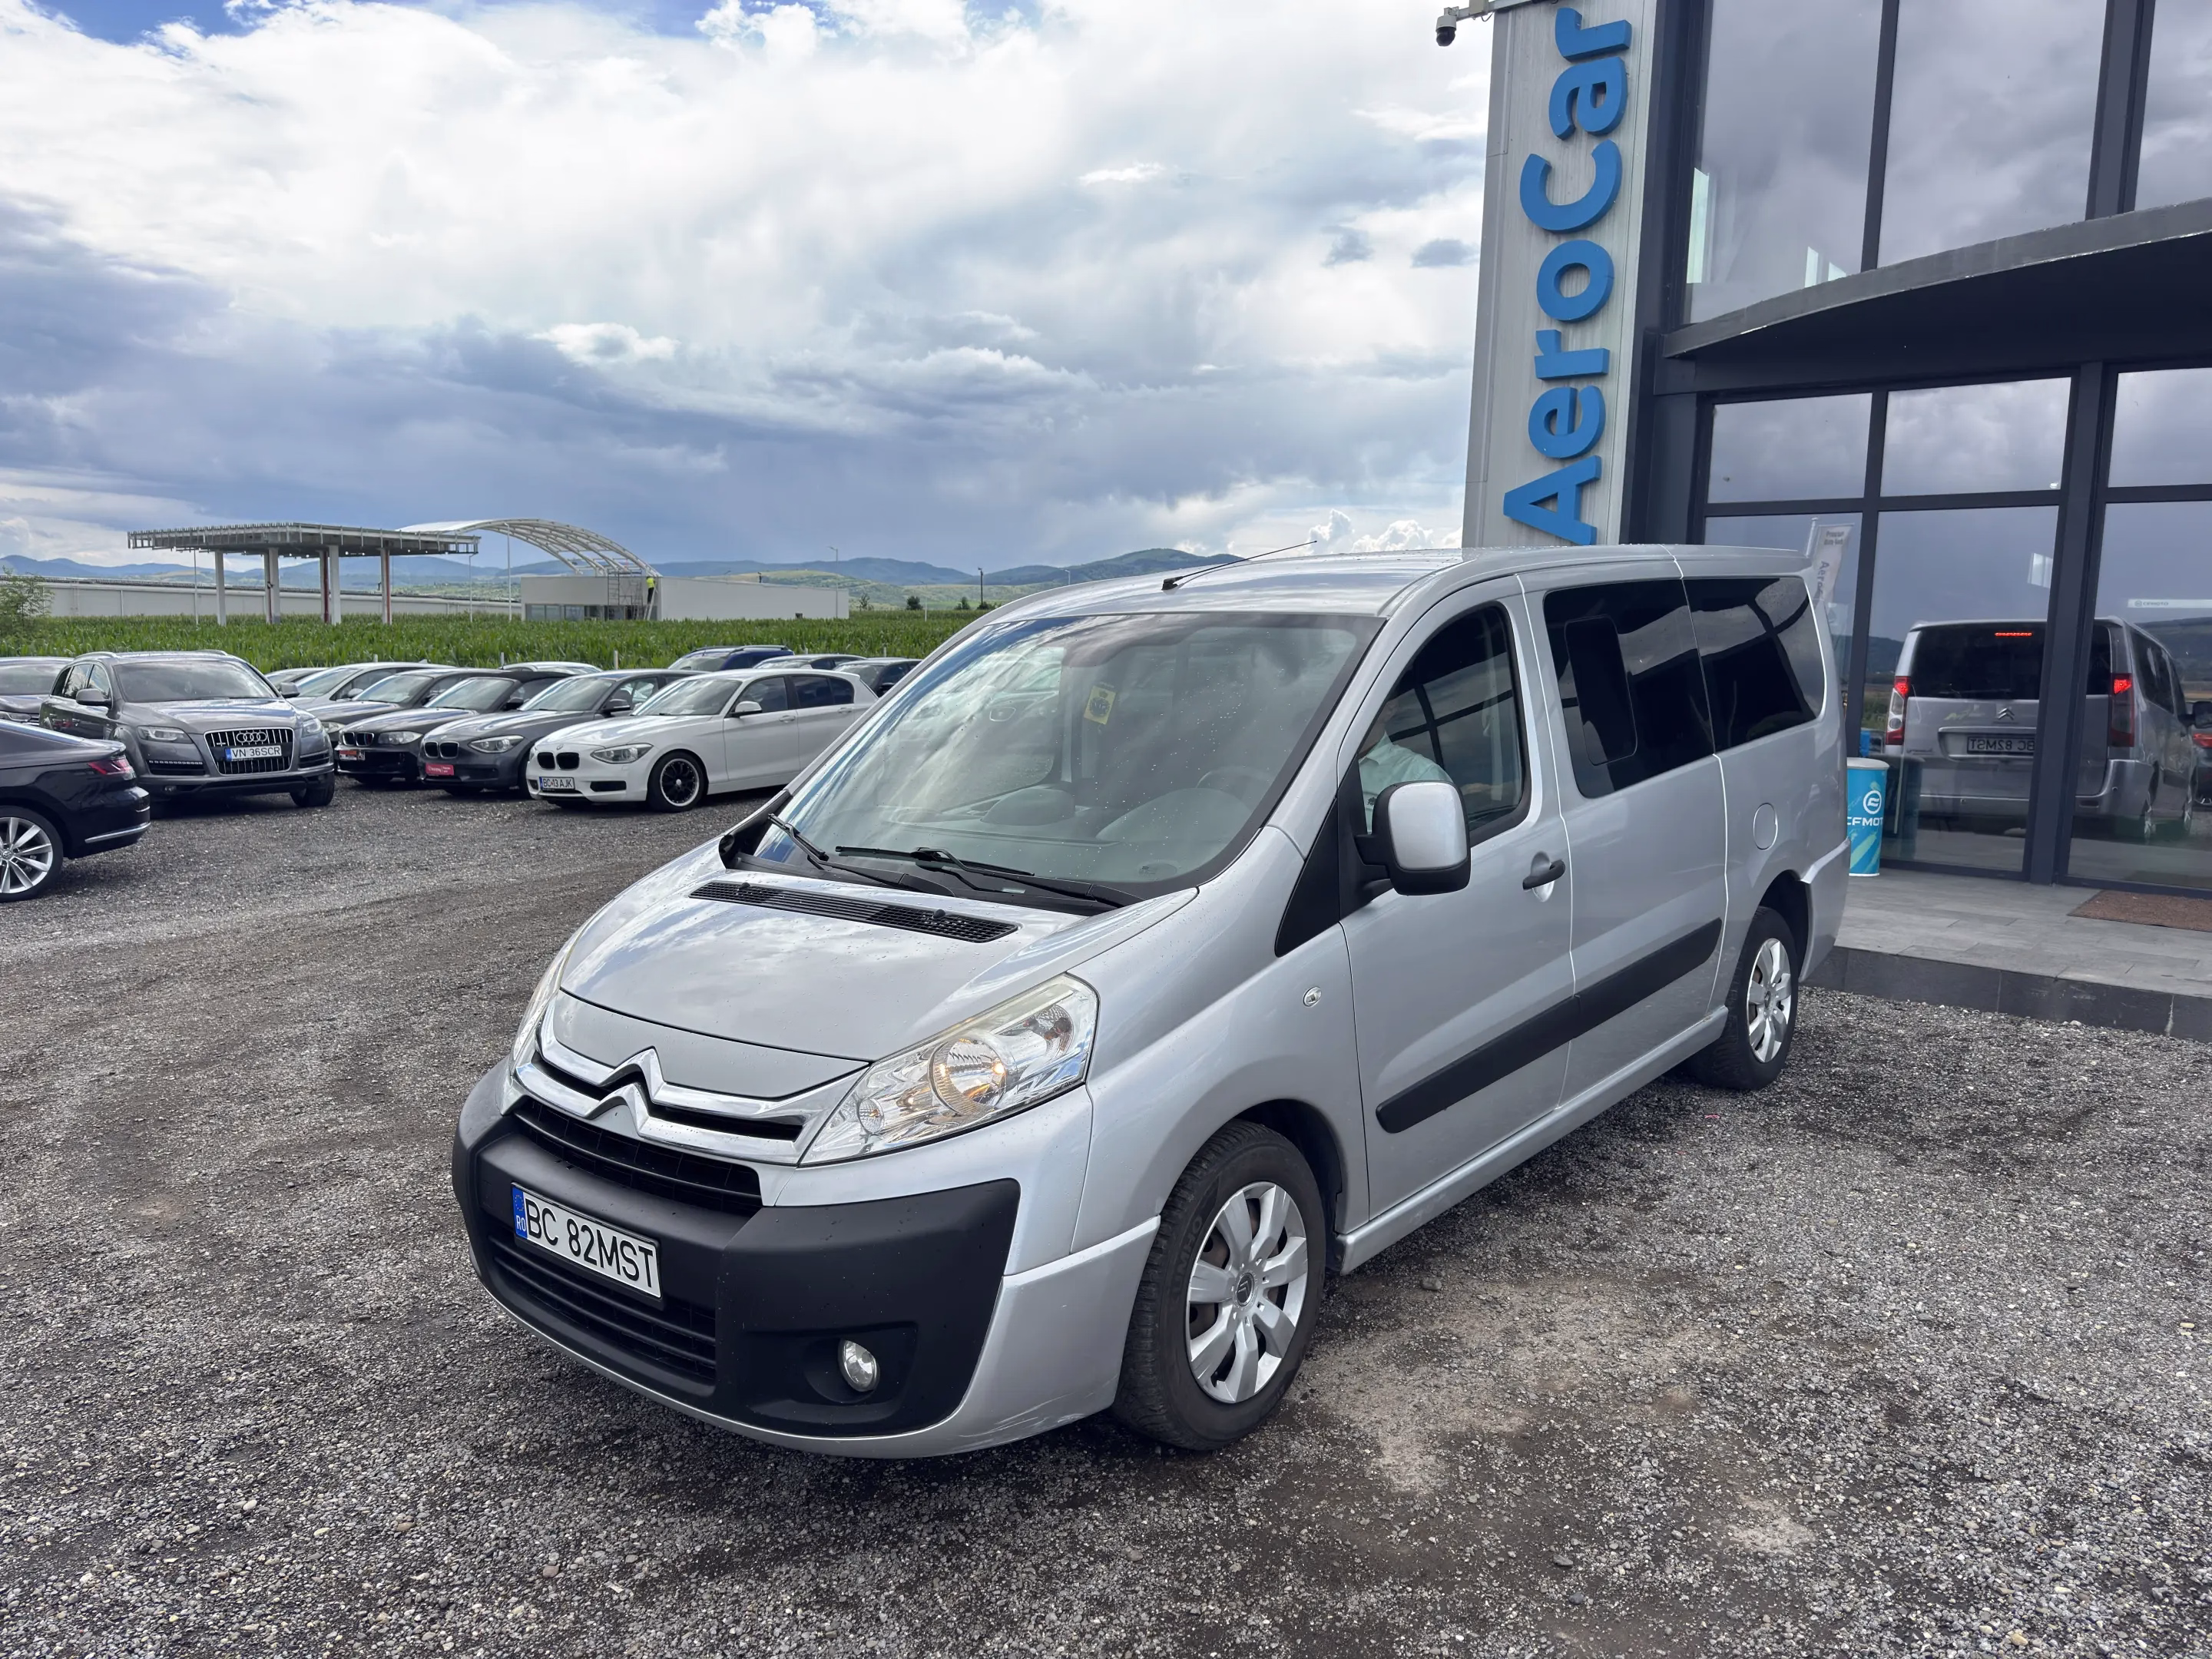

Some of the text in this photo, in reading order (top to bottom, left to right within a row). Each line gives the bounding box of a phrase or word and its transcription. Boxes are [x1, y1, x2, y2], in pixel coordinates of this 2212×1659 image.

[1503, 7, 1632, 545] AeroCar
[232, 748, 247, 758] VN
[250, 747, 280, 757] 36SCR
[560, 779, 572, 788] AJK
[516, 1215, 526, 1232] RO
[525, 1198, 653, 1288] BC 82MST
